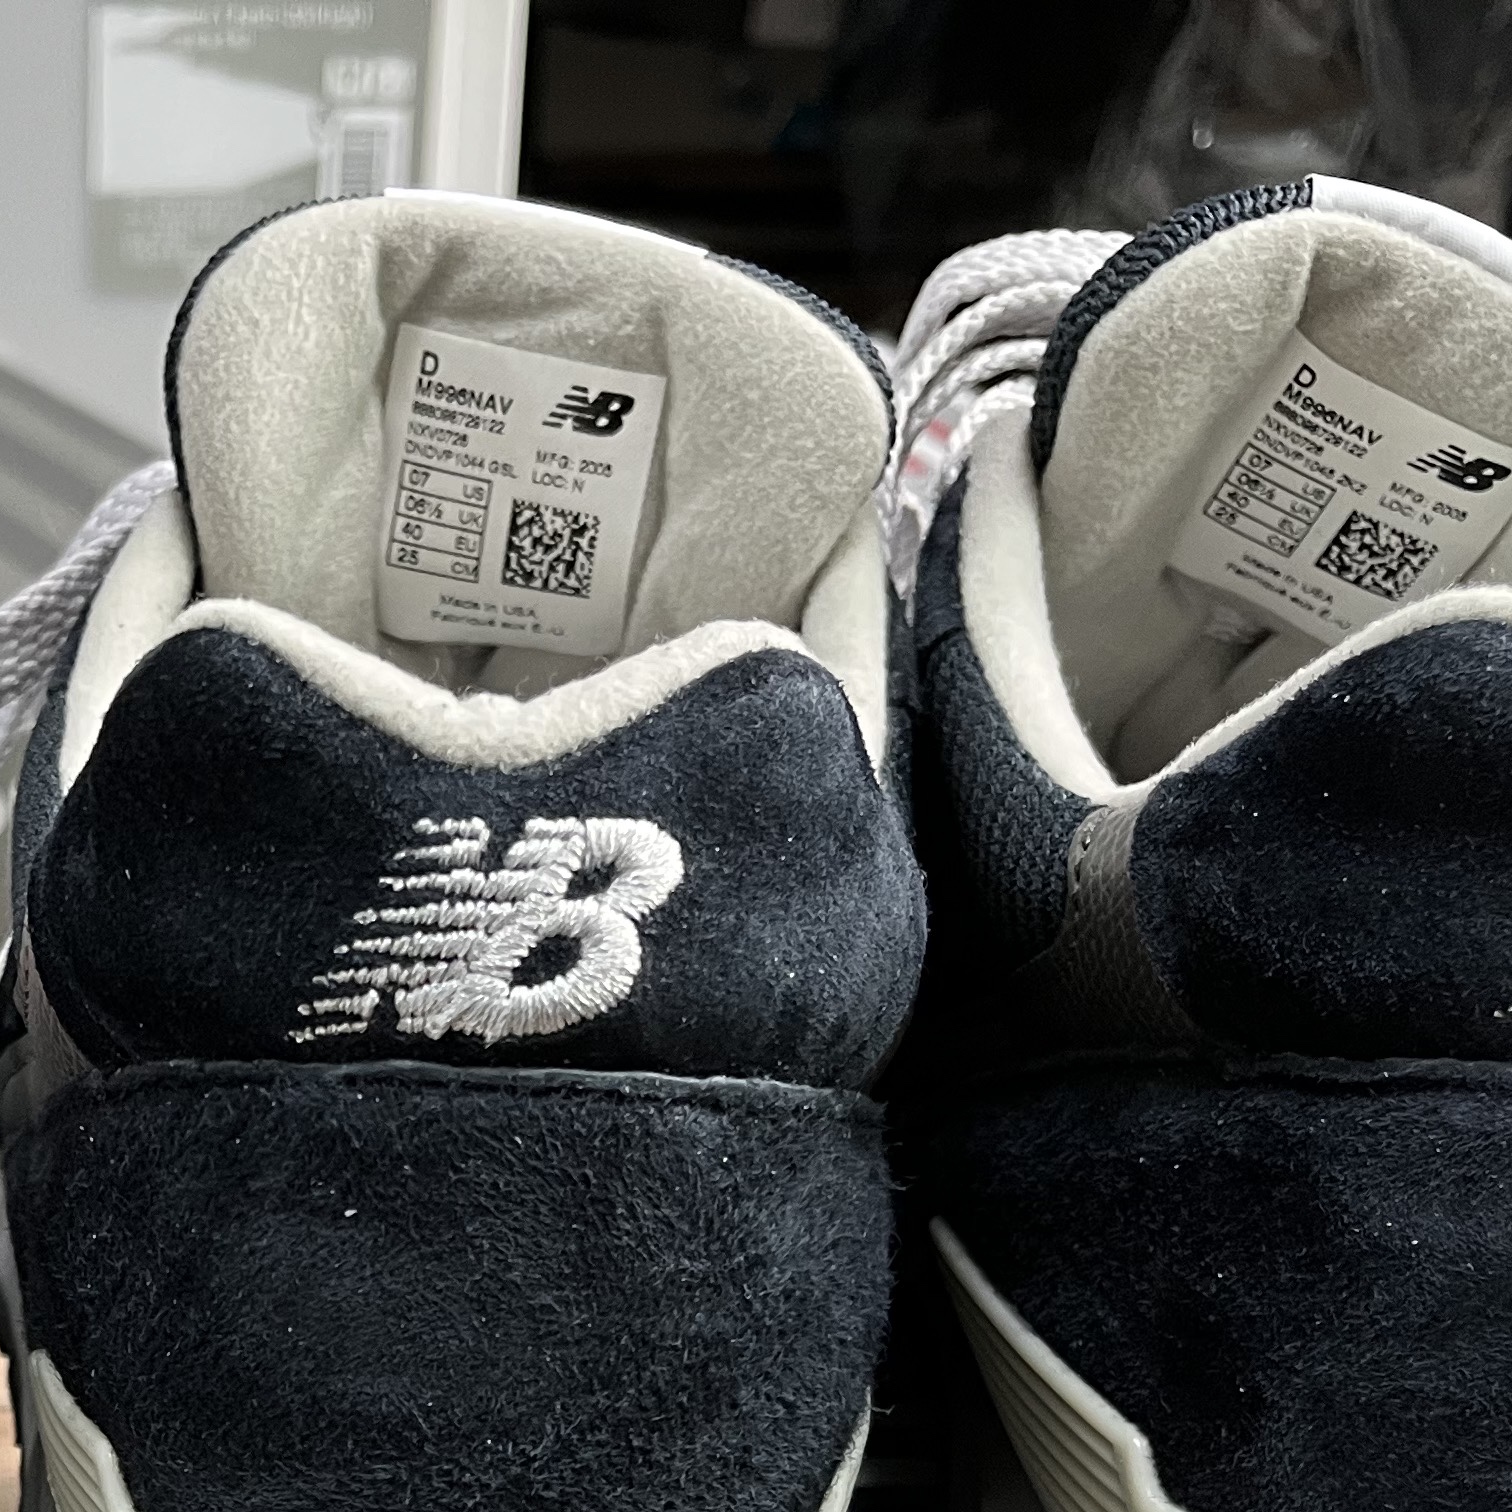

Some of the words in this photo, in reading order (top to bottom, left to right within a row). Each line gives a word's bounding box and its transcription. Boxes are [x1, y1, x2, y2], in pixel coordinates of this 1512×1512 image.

[420, 350, 438, 376] D
[1294, 363, 1317, 388] D
[416, 377, 514, 416] M996NAV
[1283, 382, 1383, 446] M996NAV
[1249, 454, 1273, 471] 07
[408, 468, 431, 488] 07
[462, 481, 485, 502] US
[457, 508, 483, 528] UK
[402, 521, 424, 541] 40
[397, 547, 420, 566] 25
